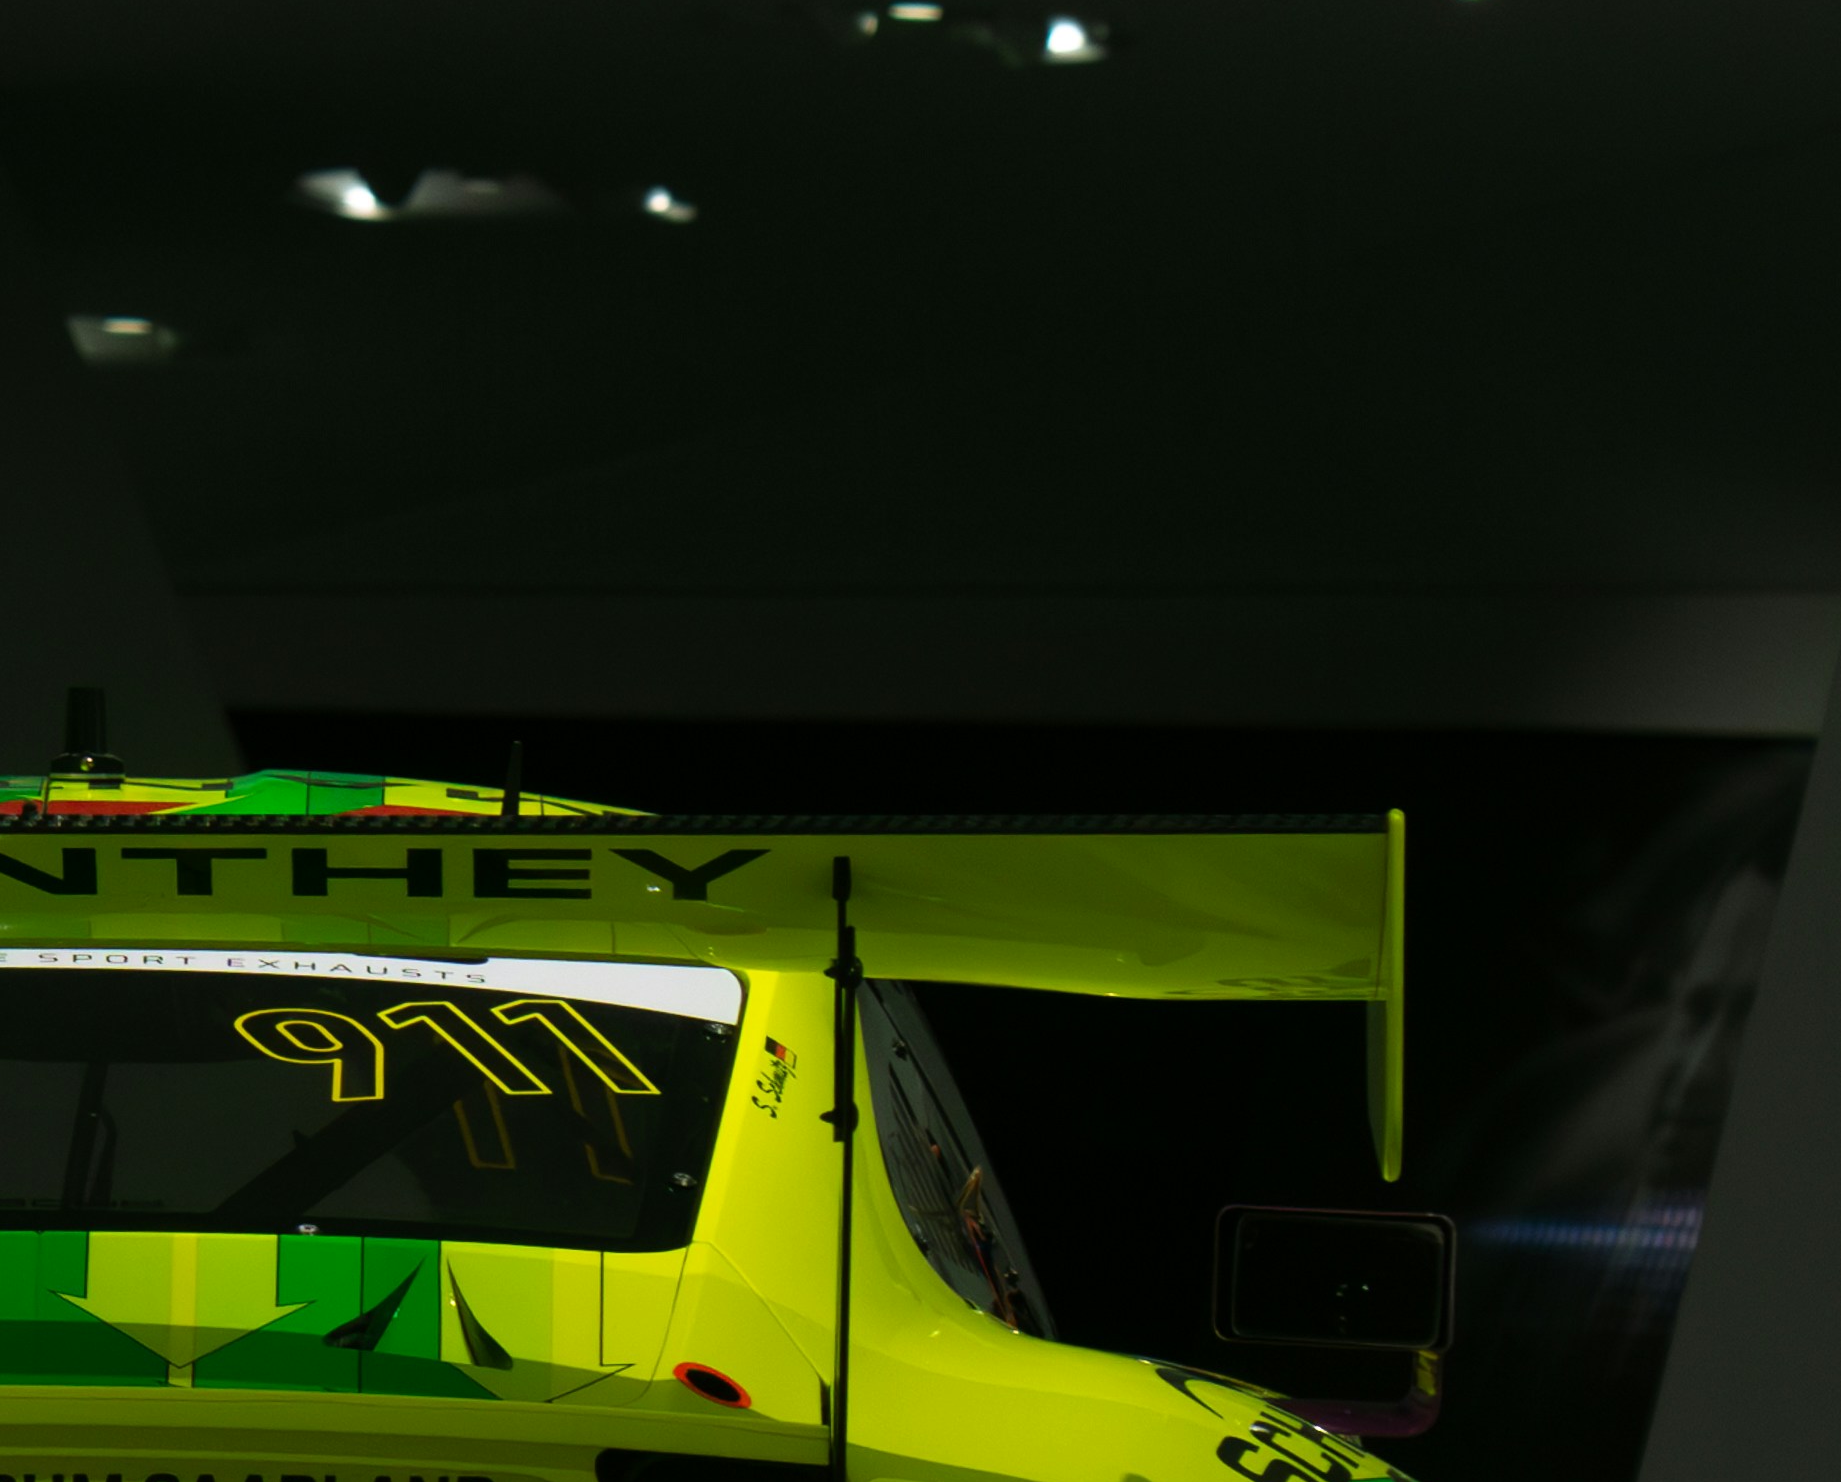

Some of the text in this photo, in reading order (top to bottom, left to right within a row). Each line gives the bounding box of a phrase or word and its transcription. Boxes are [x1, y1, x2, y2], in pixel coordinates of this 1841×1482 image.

[38, 953, 196, 965] SPORT
[227, 958, 488, 984] EXHAUSTS
[234, 999, 662, 1103] 911
